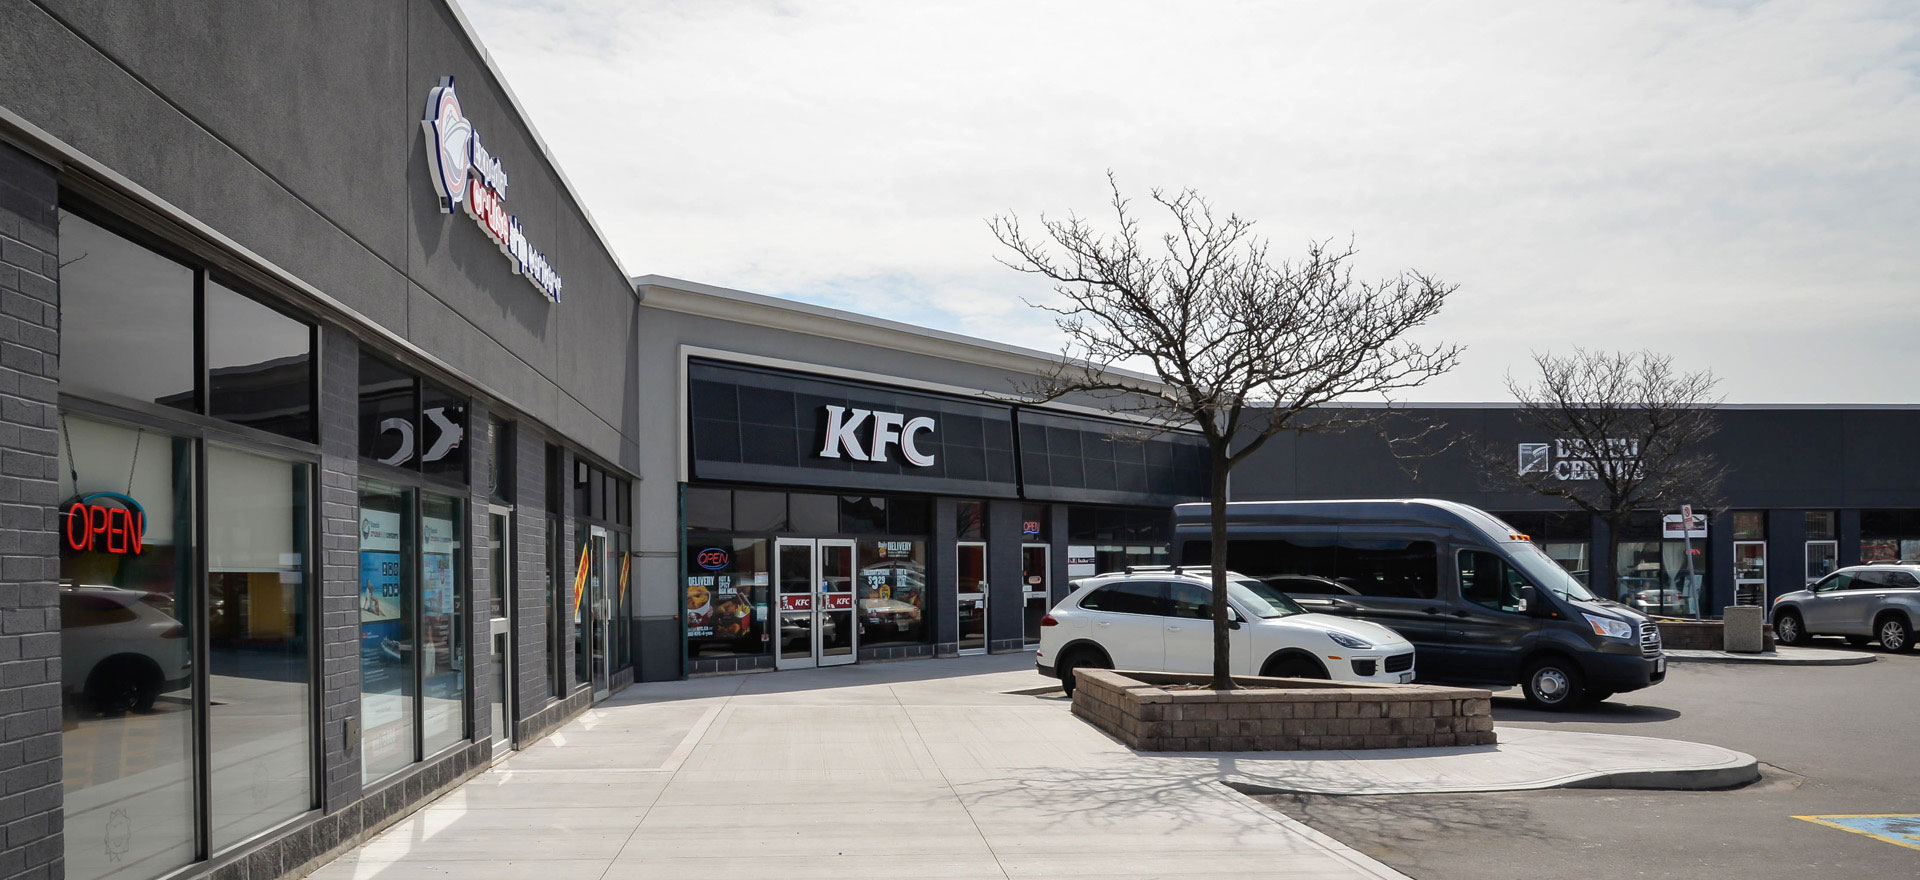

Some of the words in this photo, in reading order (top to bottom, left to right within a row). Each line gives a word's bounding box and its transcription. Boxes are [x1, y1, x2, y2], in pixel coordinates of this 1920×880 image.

[820, 405, 935, 467] KFC
[67, 502, 142, 555] OPEN
[1023, 521, 1040, 531] OPEN
[888, 541, 911, 551] DELIVERY
[698, 552, 728, 565] OPEN
[688, 576, 714, 586] DELIVERY
[836, 597, 850, 605] KFC
